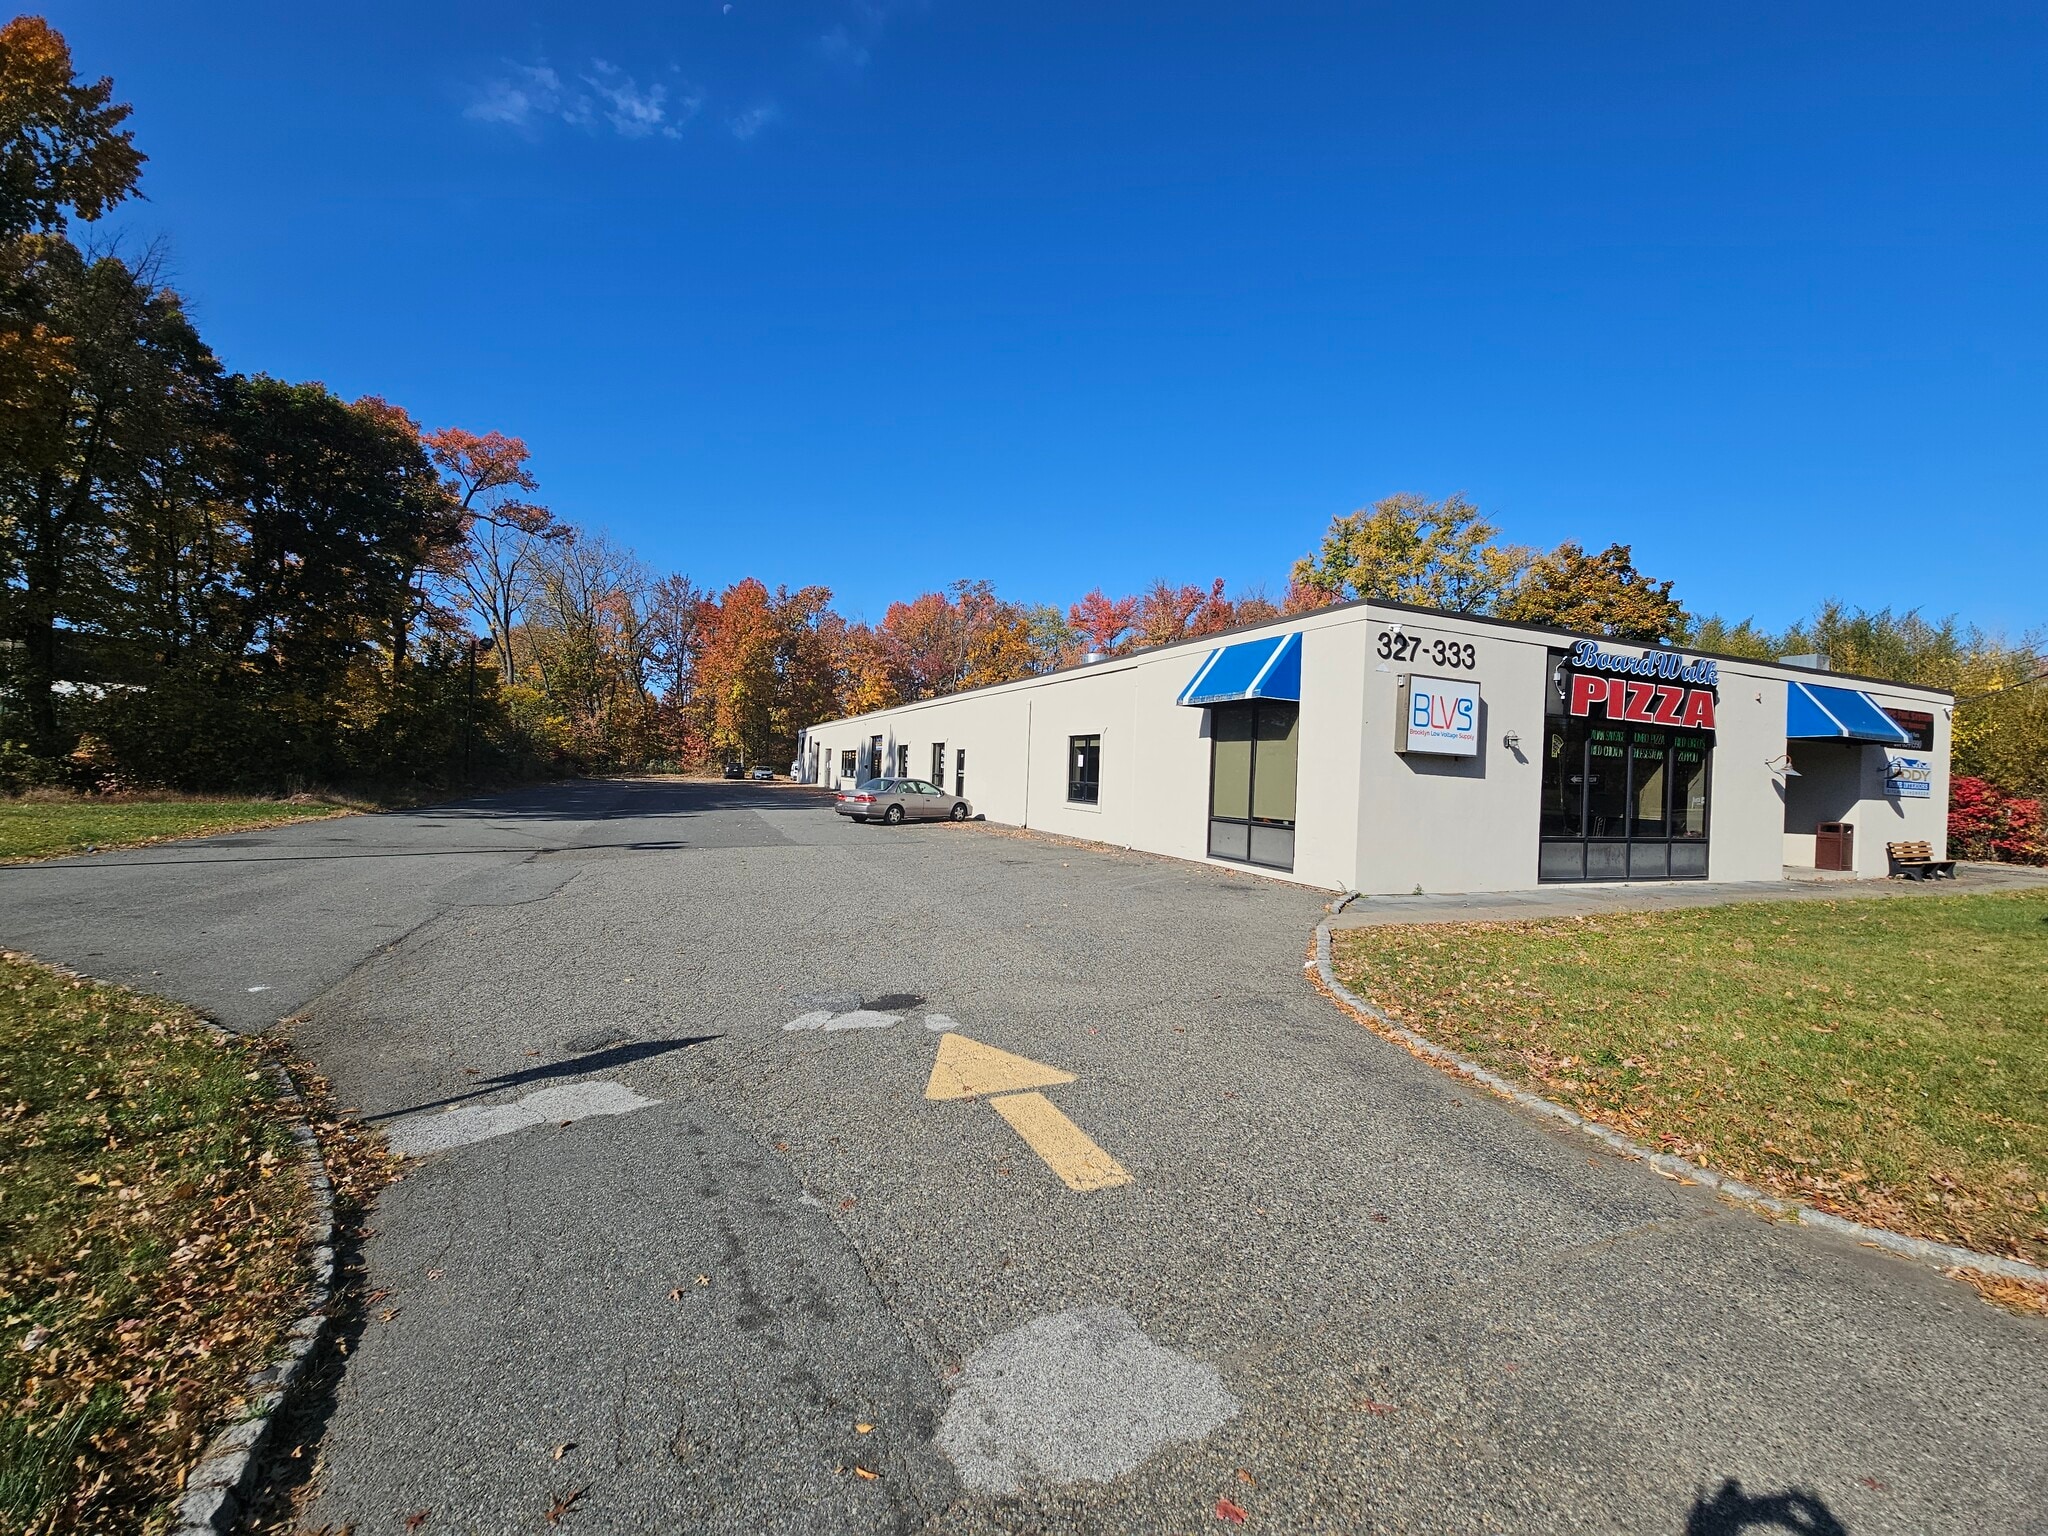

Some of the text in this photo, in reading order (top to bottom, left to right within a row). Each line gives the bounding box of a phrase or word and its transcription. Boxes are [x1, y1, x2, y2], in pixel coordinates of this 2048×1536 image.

[1377, 632, 1475, 670] 327-333
[1572, 640, 1719, 686] BoardWalk
[1414, 693, 1473, 731] BLVS
[1570, 674, 1716, 730] PIZZA
[1410, 729, 1430, 737] Brooklyn
[1441, 731, 1458, 739] Voltage
[1459, 733, 1474, 741] Supply
